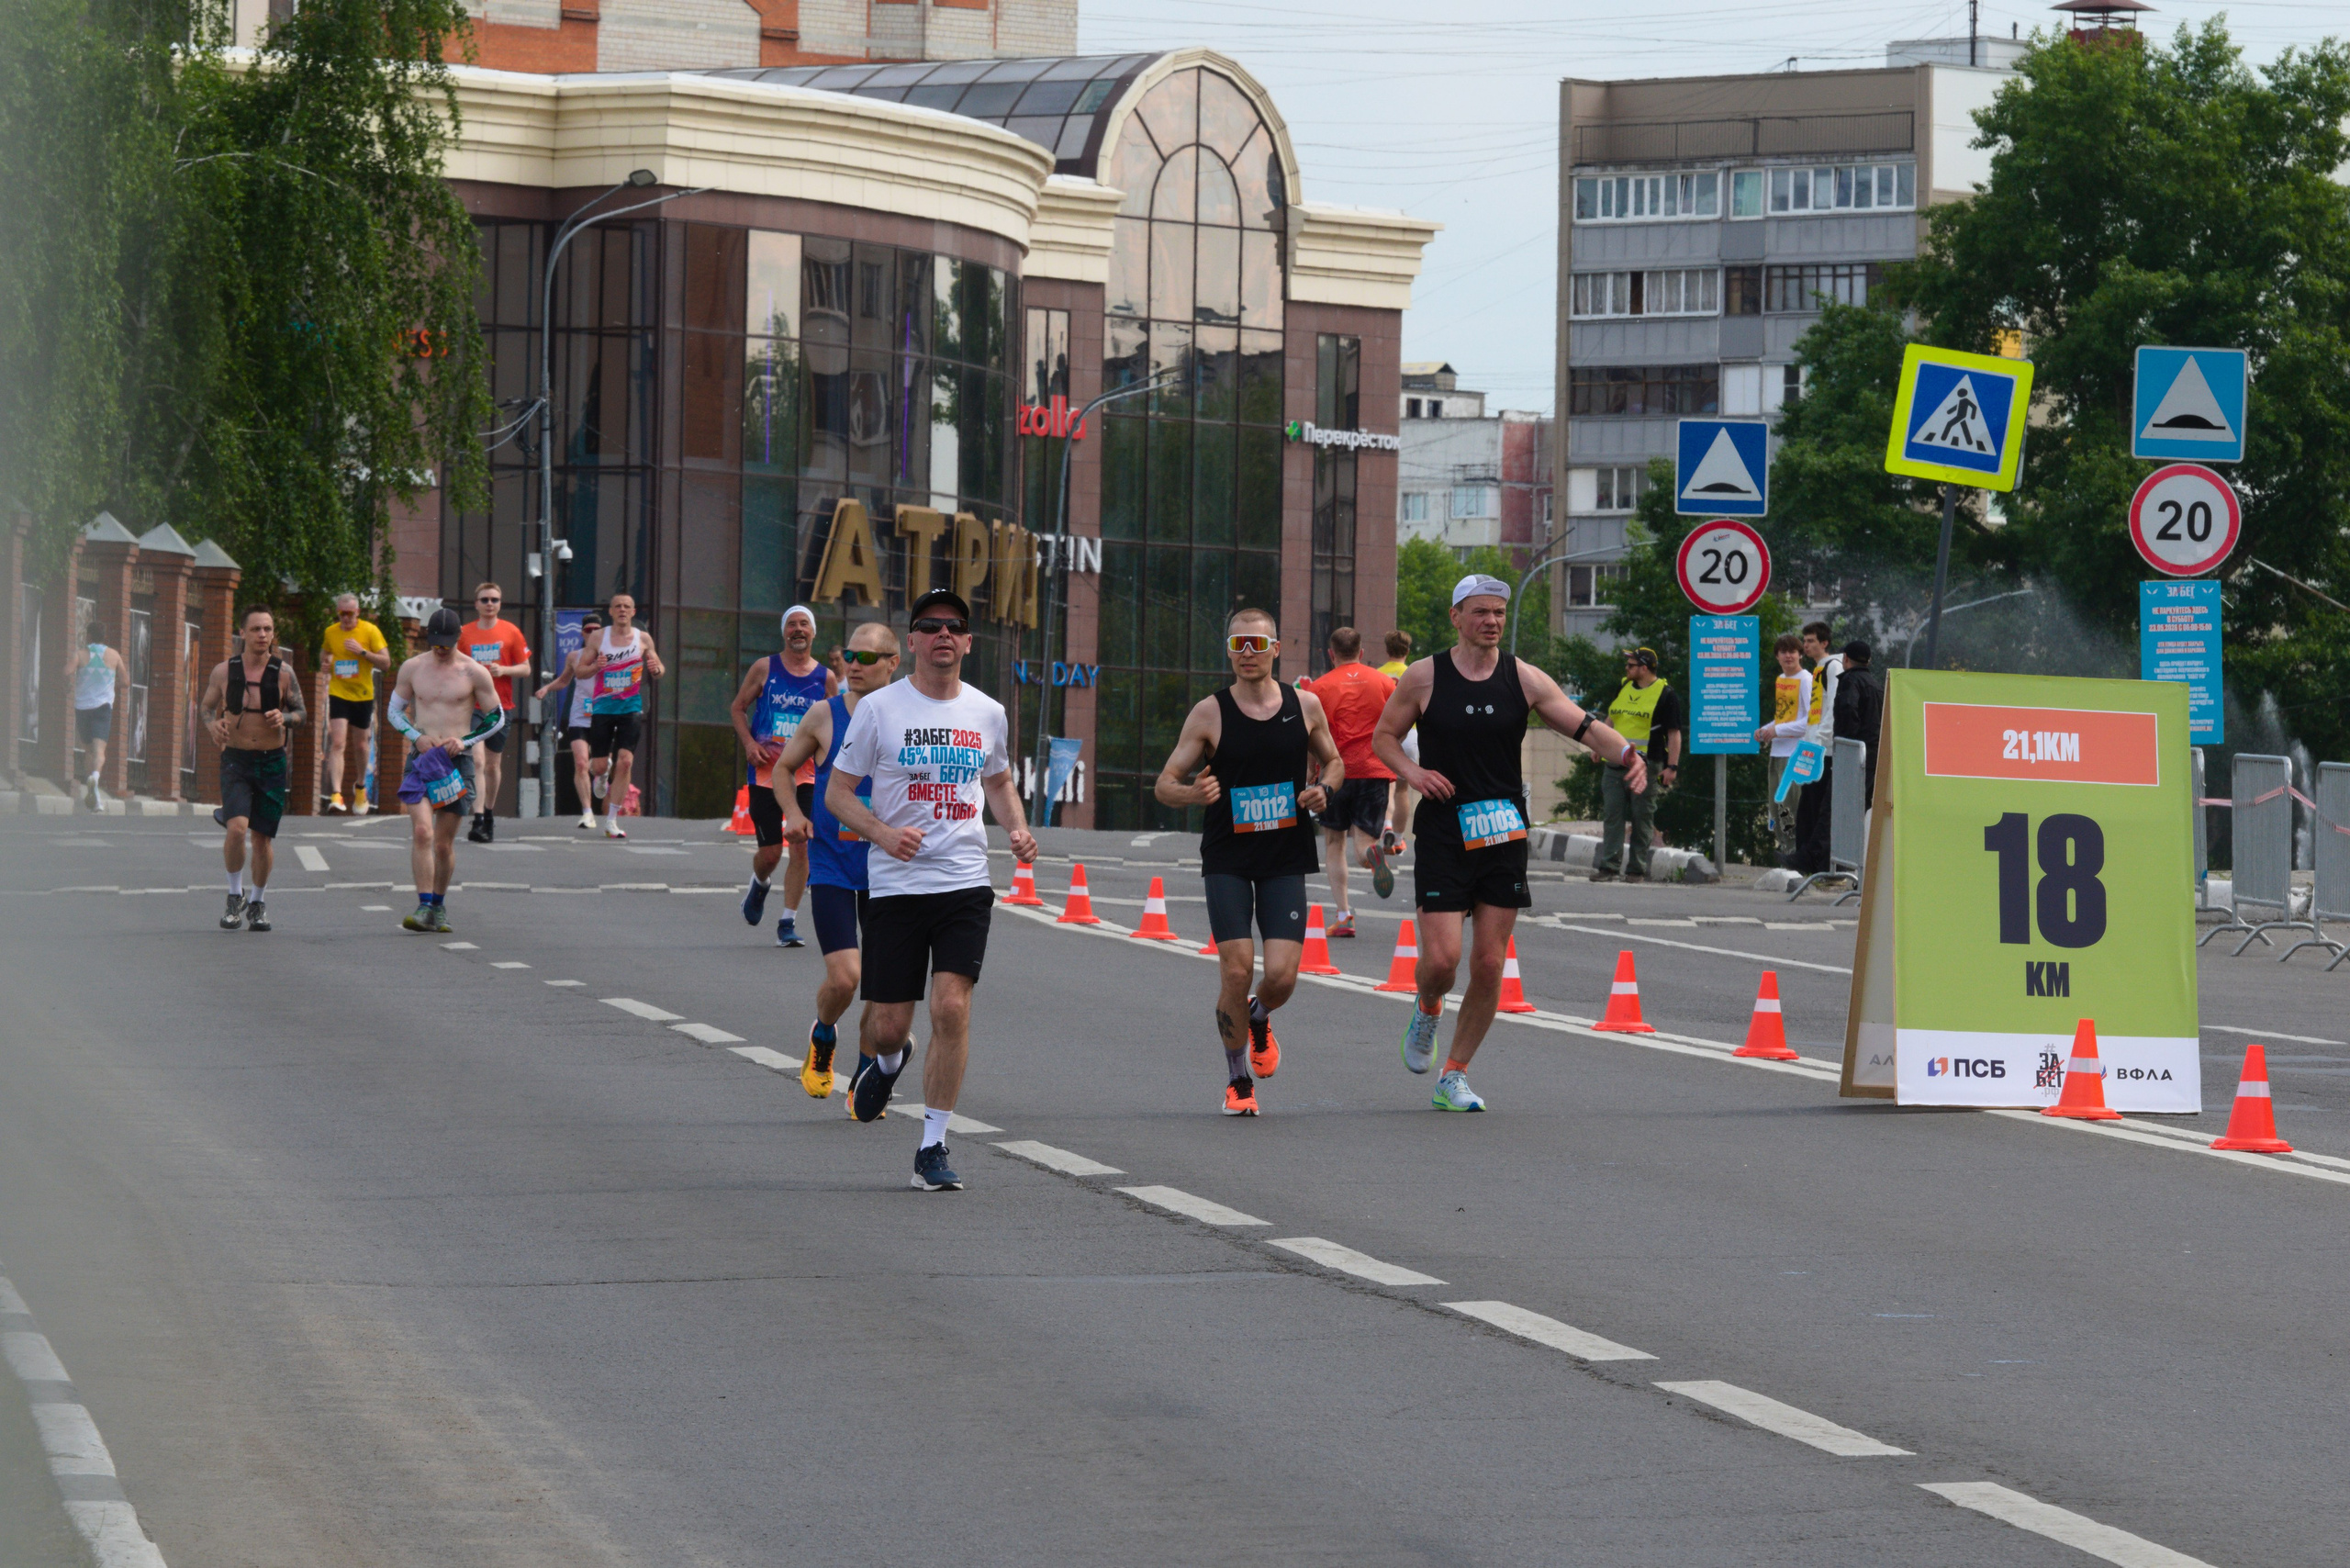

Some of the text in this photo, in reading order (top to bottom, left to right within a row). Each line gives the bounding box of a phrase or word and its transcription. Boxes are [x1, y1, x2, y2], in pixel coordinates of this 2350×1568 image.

[1019, 395, 1086, 440] zolla
[1303, 420, 1401, 451] Перекрёсток
[2155, 499, 2212, 543] 20
[1699, 548, 1748, 585] 20
[1052, 661, 1101, 687] DAY
[898, 746, 928, 766] 45%
[2002, 729, 2079, 764] 21,1КМ
[908, 783, 957, 802] ВМЕСТЕ
[934, 802, 943, 820] С
[1239, 795, 1289, 821] 70112
[1465, 809, 1519, 838] 70103
[1984, 812, 2107, 948] 18
[2025, 960, 2070, 998] КМ
[1953, 1058, 2006, 1079] ПСБ
